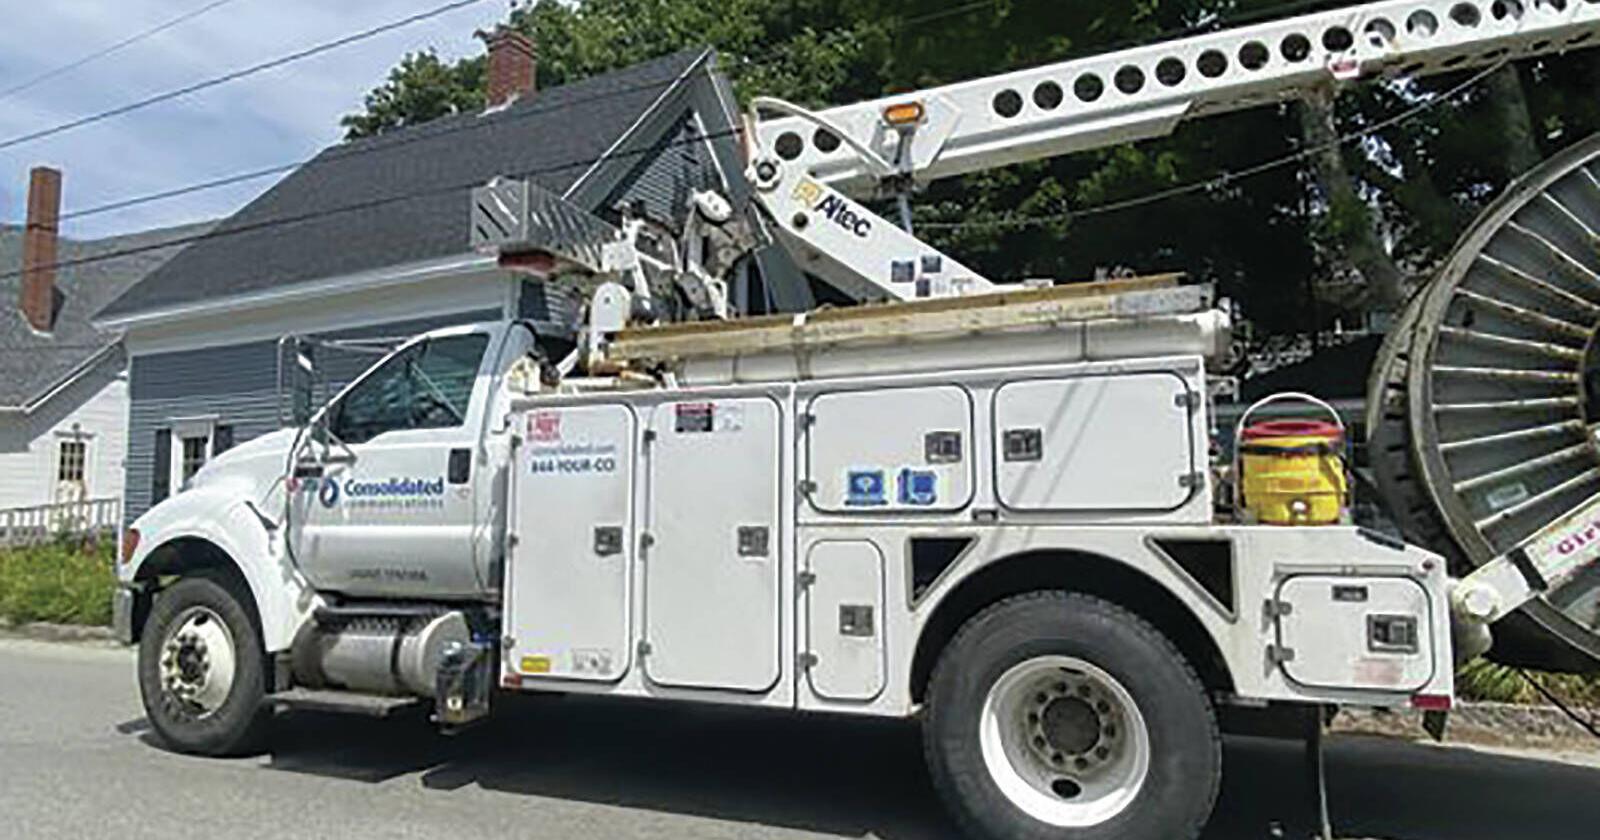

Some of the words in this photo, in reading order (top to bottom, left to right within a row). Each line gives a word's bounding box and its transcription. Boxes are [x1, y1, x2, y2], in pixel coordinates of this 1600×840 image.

[813, 194, 871, 238] Altec
[344, 476, 444, 496] Consolidated
[344, 498, 444, 509] communications
